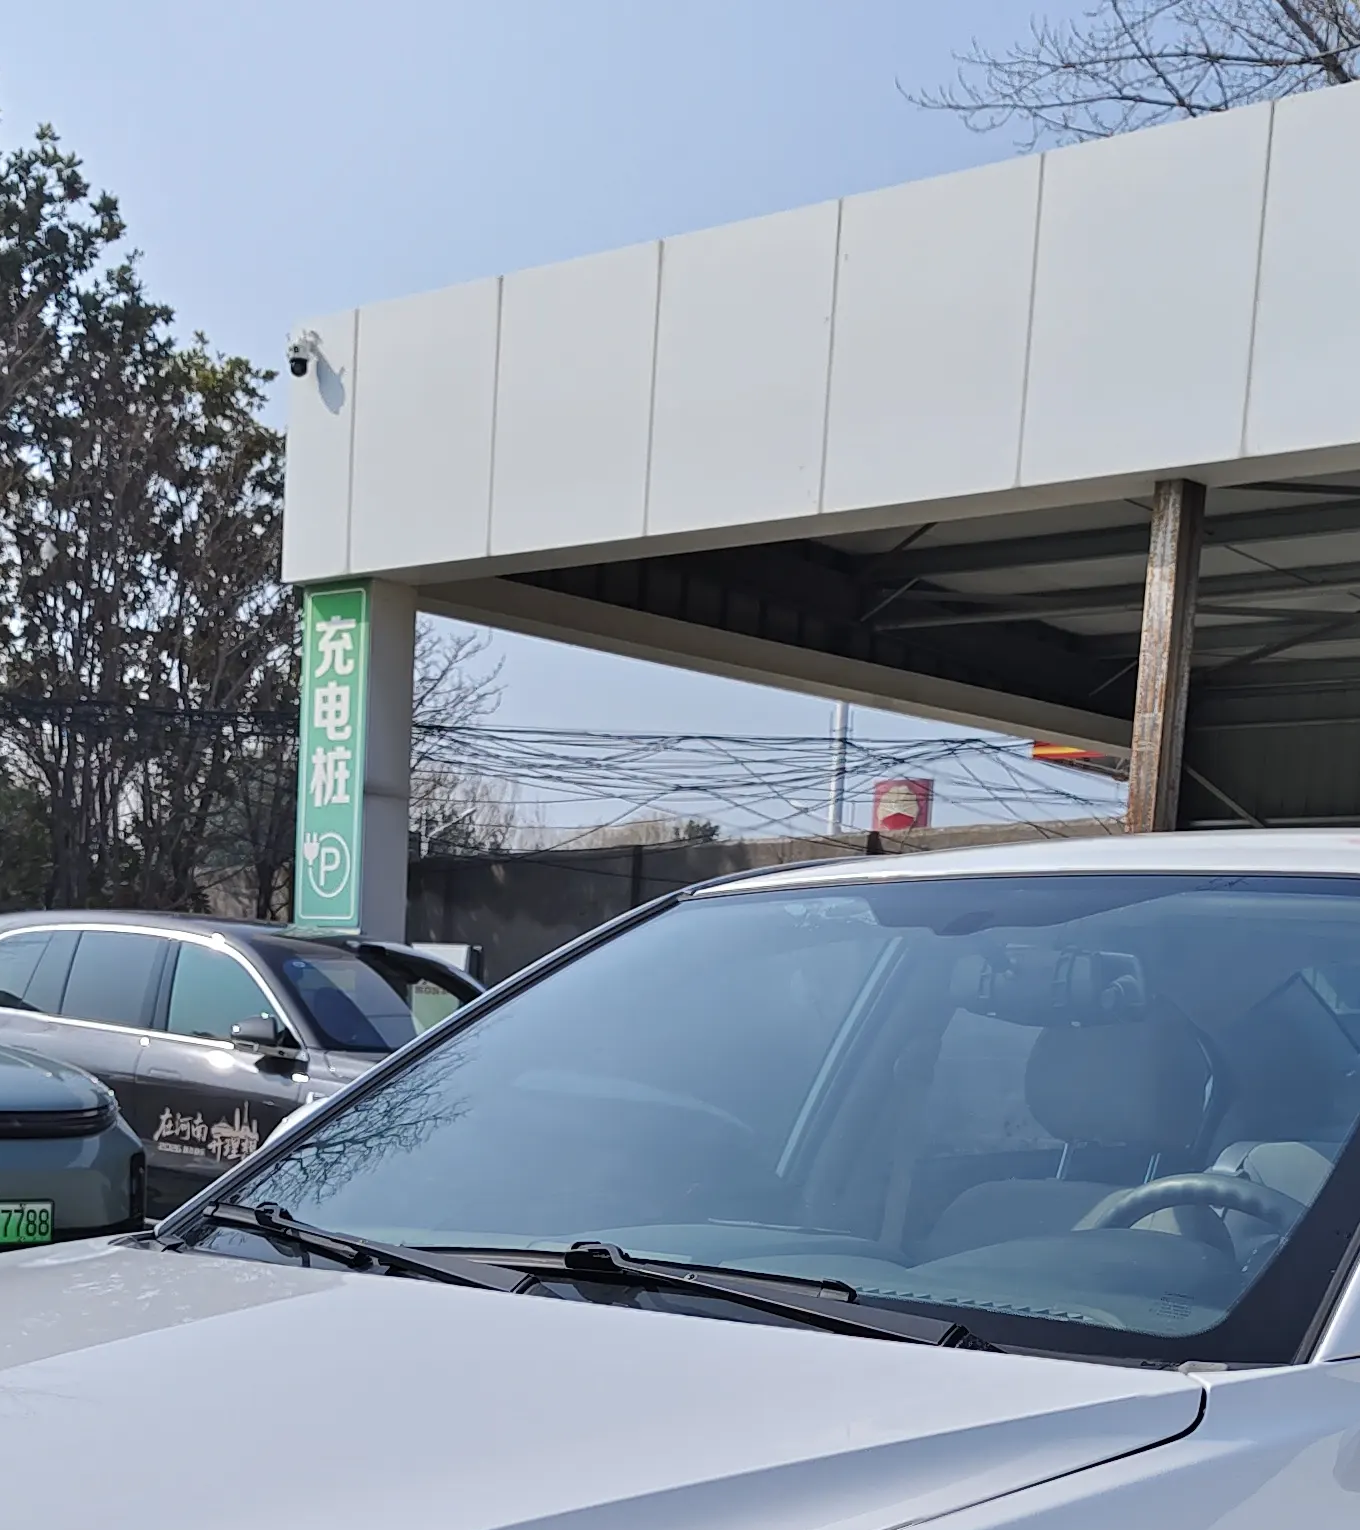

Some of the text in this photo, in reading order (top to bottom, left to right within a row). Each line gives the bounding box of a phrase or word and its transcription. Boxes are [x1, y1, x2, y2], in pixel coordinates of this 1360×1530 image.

[310, 615, 358, 807] 充电桩
[153, 1107, 208, 1141] 在河南
